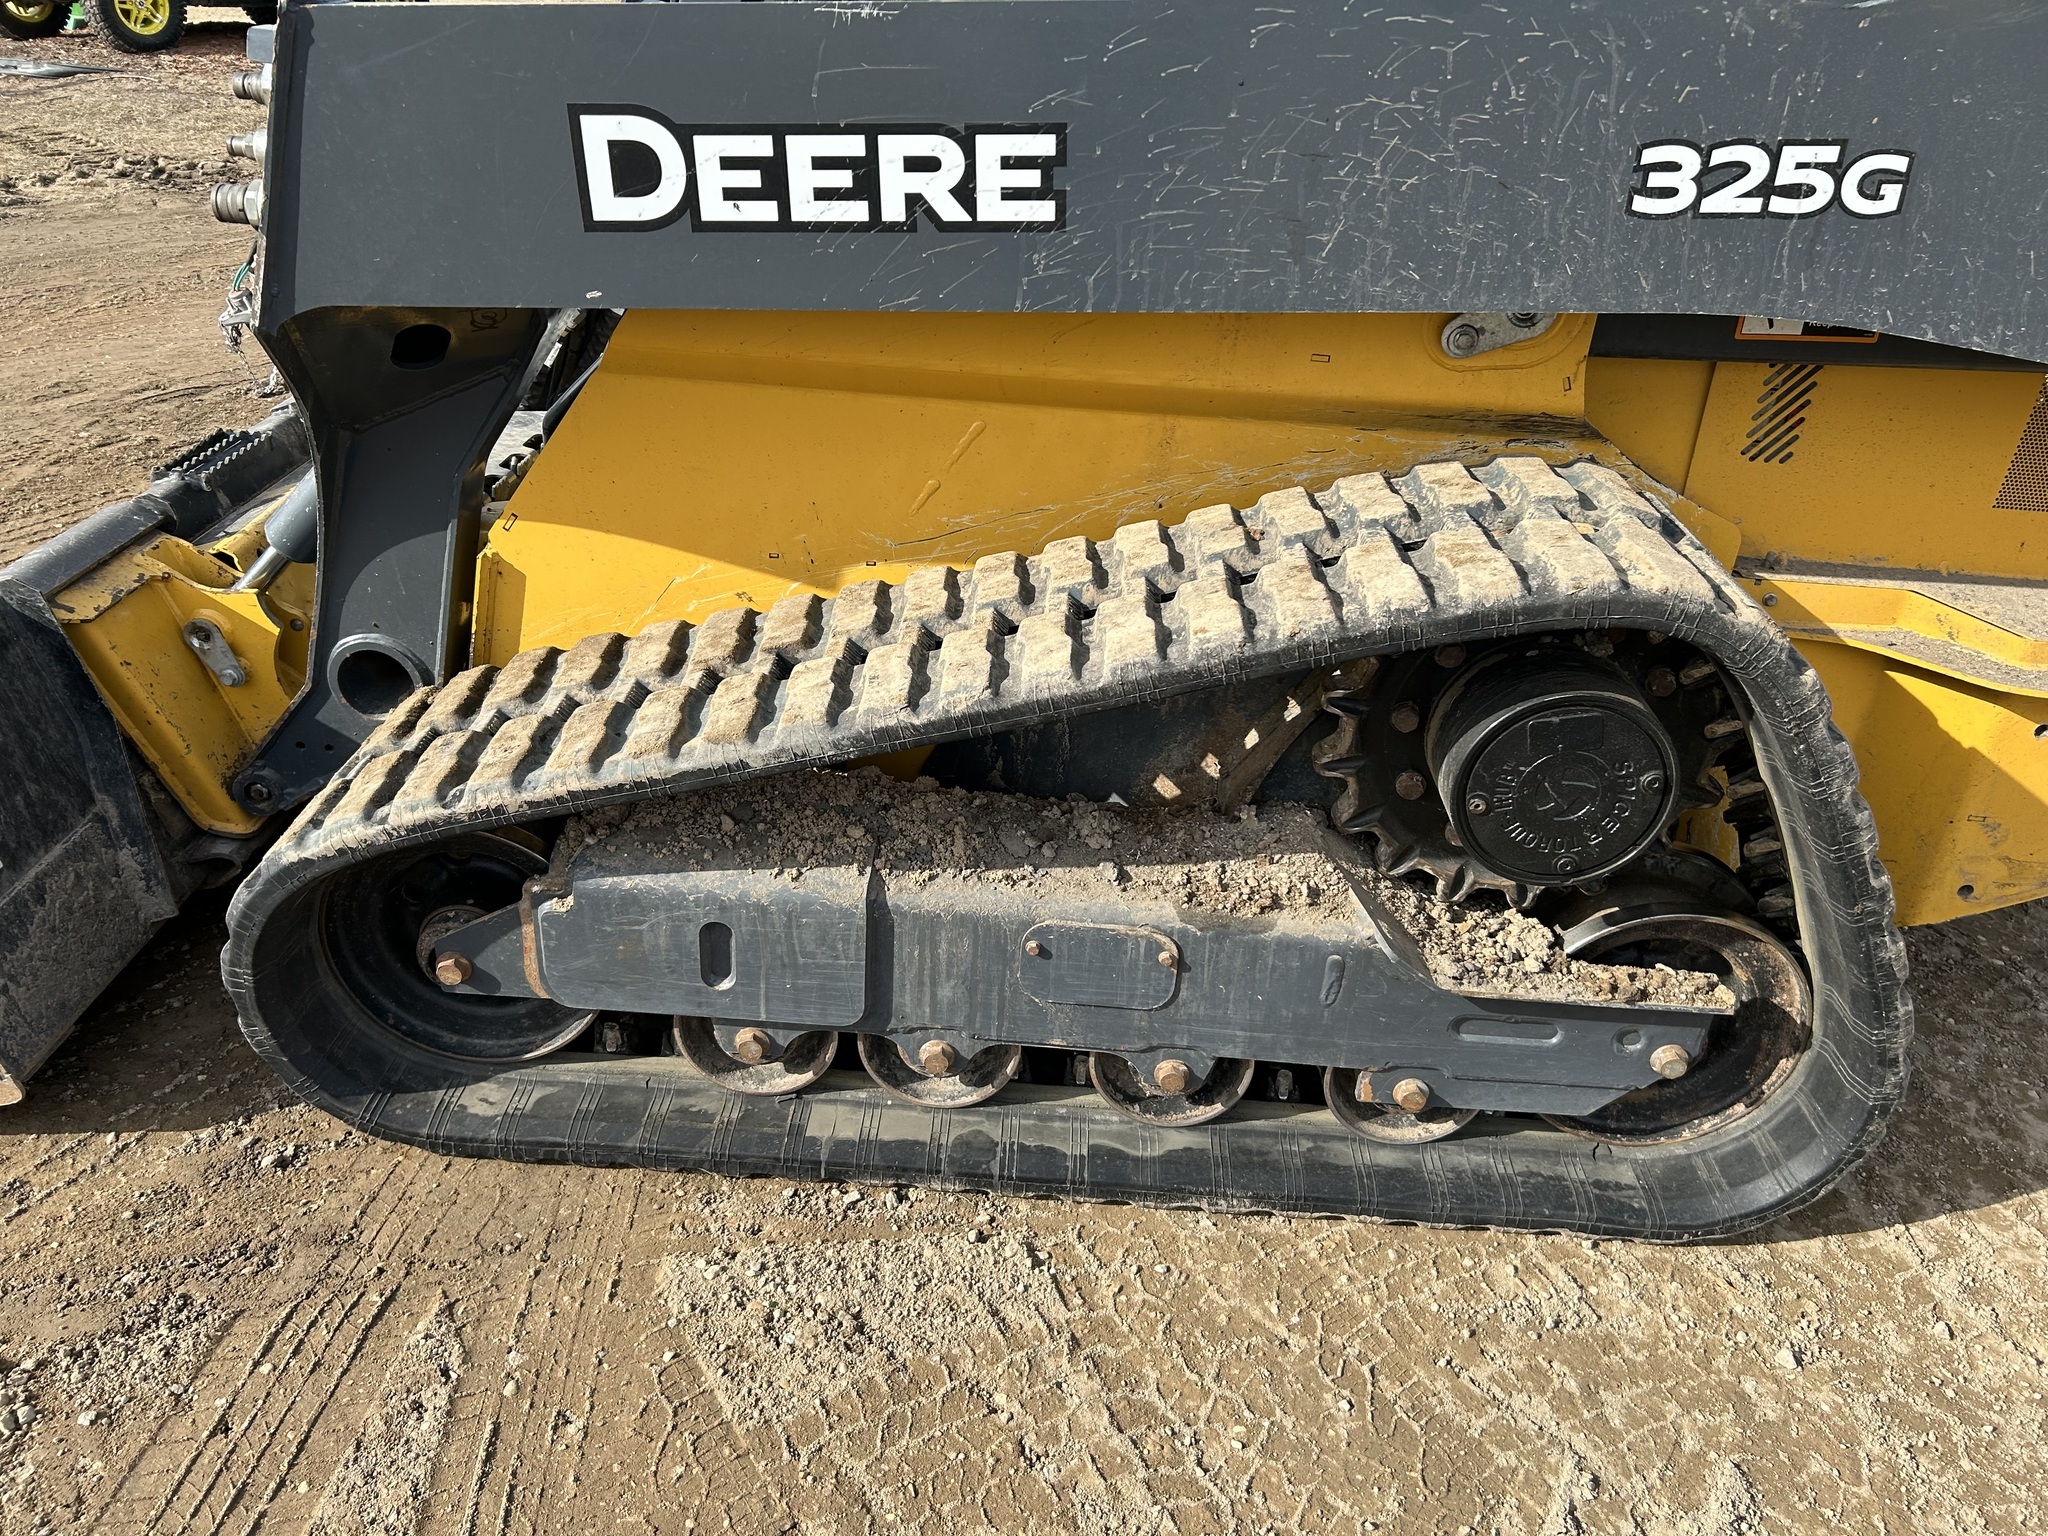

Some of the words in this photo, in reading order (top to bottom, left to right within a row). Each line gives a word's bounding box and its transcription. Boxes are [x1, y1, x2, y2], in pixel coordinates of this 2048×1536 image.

[578, 114, 1057, 222] DEERE
[1630, 144, 1911, 215] 325G
[1583, 760, 1637, 845] SPICER
